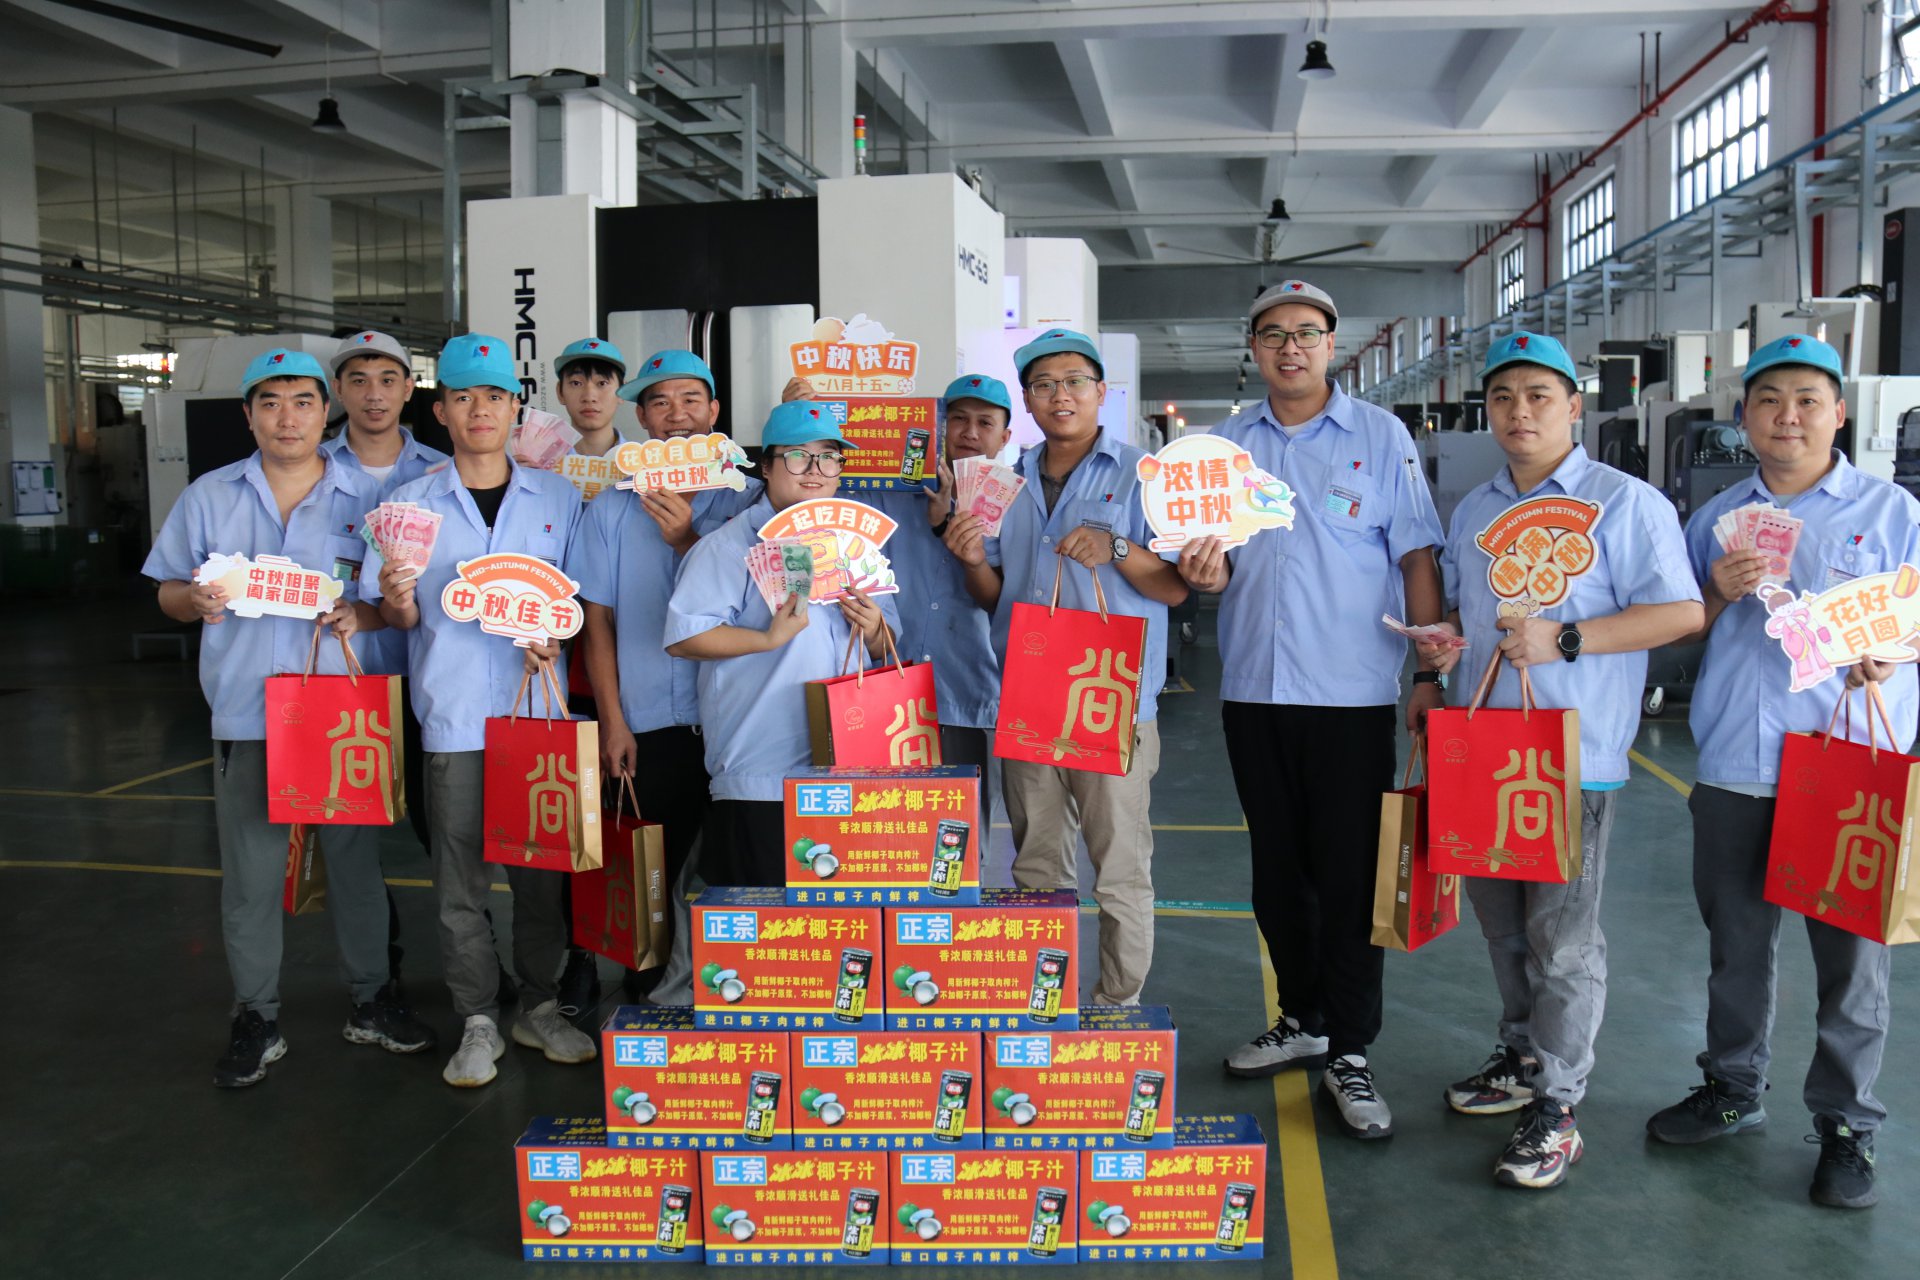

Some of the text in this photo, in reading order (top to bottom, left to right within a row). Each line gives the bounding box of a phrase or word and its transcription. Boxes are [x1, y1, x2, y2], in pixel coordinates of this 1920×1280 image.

[958, 244, 988, 285] HMC-63
[796, 346, 911, 371] 中秋快乐
[645, 467, 709, 489] 过中秋
[1163, 459, 1230, 493] 浓情
[1166, 493, 1233, 526] 中秋
[774, 506, 881, 538] 一起吃月饼
[1489, 506, 1588, 548] MID-AUTUMN FESTIVAL
[249, 568, 320, 590] 中秋相聚
[467, 561, 567, 596] MID-AUTUMN FESTIVAL
[246, 583, 318, 606] 阖家团圆
[451, 588, 574, 629] 中秋佳节
[1823, 584, 1889, 629] 花好
[1842, 614, 1900, 655] 月圆
[801, 787, 849, 813] 正宗
[839, 822, 928, 834] 香浓顺滑送礼佳品
[797, 891, 920, 902] 进口椰子肉鲜榨
[708, 915, 754, 940] 正宗
[902, 917, 949, 942] 正宗
[745, 949, 832, 961] 香浓顺滑送礼佳品
[939, 950, 1027, 962] 香浓顺滑送礼佳品
[705, 1015, 824, 1027] 进口椰子肉鲜榨
[897, 1018, 1018, 1028] 进口椰子肉鲜榨
[619, 1040, 664, 1063] 正宗
[808, 1040, 854, 1064] 正宗
[1001, 1039, 1047, 1064] 正宗
[656, 1072, 741, 1084] 香浓顺滑送礼佳品
[845, 1072, 932, 1084] 香浓顺滑送礼佳品
[1038, 1072, 1124, 1084] 香浓顺滑送礼佳品
[617, 1136, 735, 1147] 进口椰子肉鲜榨
[805, 1137, 923, 1148] 进口椰子肉鲜榨
[995, 1137, 1114, 1147] 进口椰子肉鲜榨
[533, 1155, 577, 1178] 正宗
[718, 1159, 763, 1182] 正宗
[906, 1157, 951, 1181] 正宗
[1096, 1155, 1142, 1178] 正宗
[570, 1186, 653, 1197] 香浓顺滑送礼佳品
[755, 1190, 840, 1201] 香浓顺滑送礼佳品
[942, 1188, 1027, 1200] 香浓顺滑送礼佳品
[1132, 1185, 1216, 1196] 香浓顺滑送礼佳品
[533, 1248, 647, 1258] 进口椰子肉鲜榨
[716, 1252, 832, 1263] 进口椰子肉鲜榨
[902, 1252, 1018, 1262] 进口椰子肉鲜榨
[1089, 1248, 1206, 1258] 进口椰子肉鲜榨
